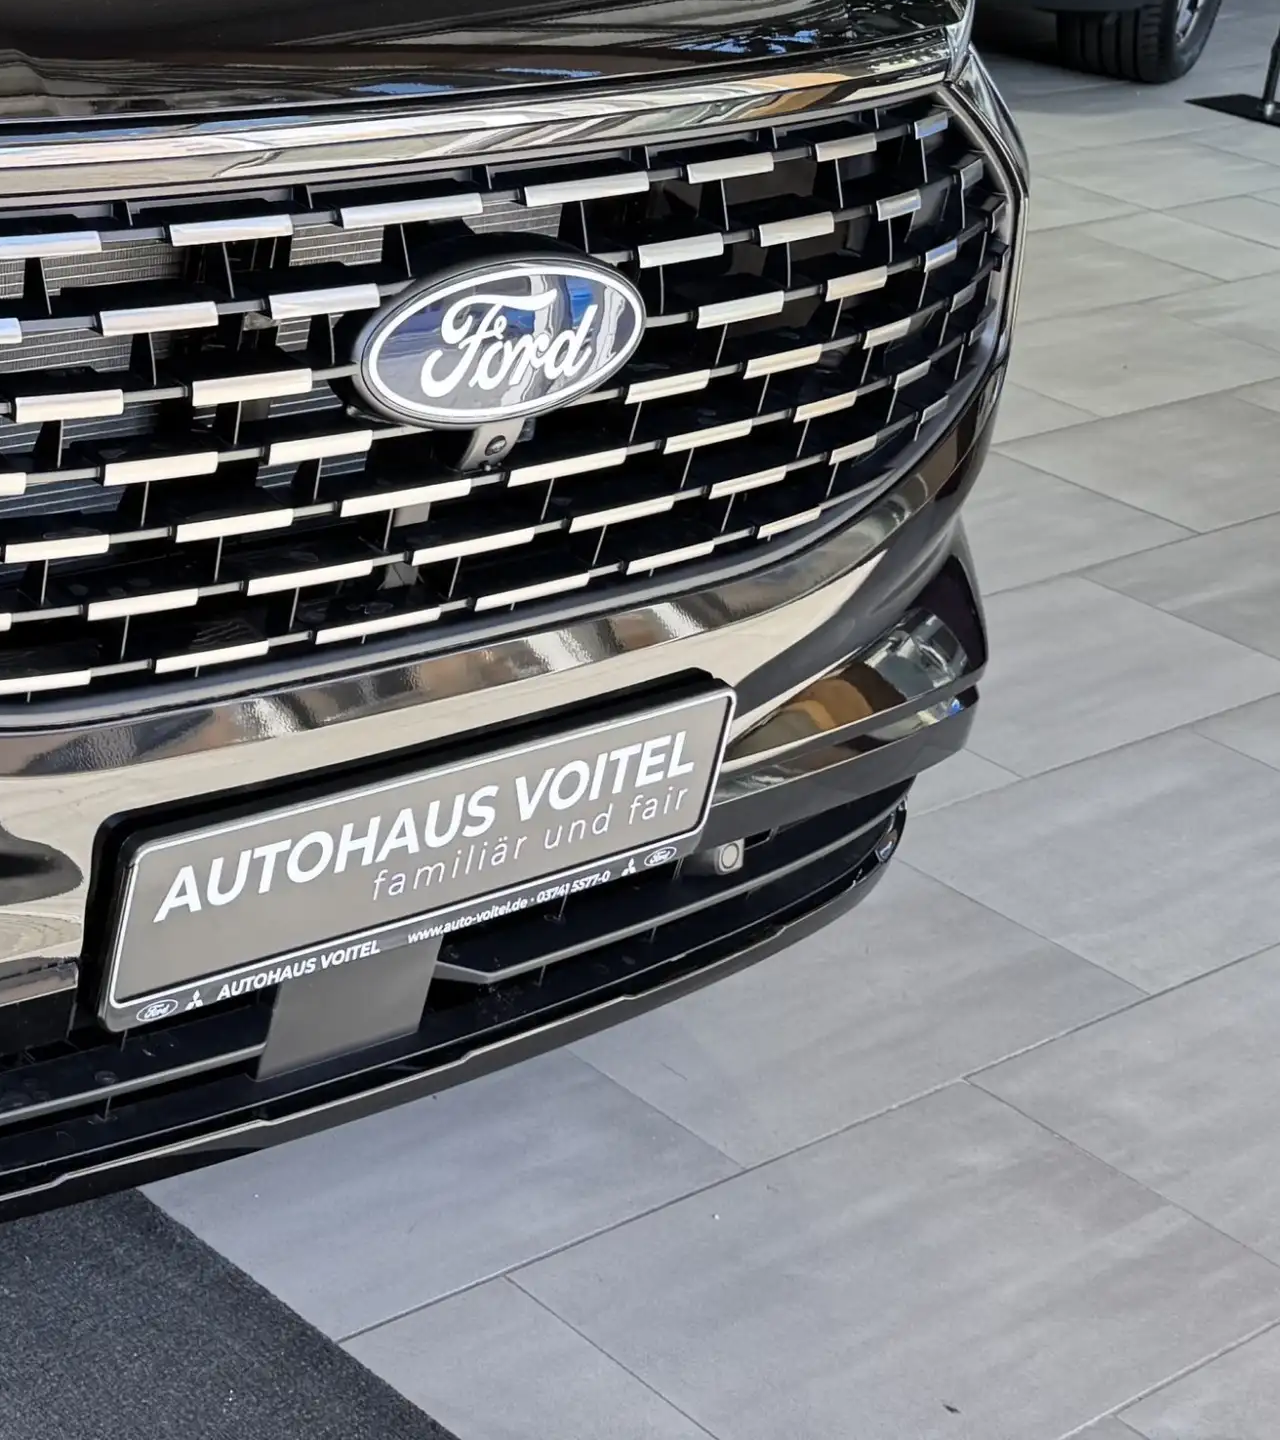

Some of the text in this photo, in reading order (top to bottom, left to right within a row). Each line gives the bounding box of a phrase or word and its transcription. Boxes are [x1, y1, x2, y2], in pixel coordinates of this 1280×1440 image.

[421, 289, 598, 398] Ford
[152, 730, 696, 923] AUTOHAUS VOITEL
[373, 787, 690, 901] familiär und fair
[216, 957, 317, 1001] AUTOHAUS
[319, 939, 381, 970] VOITEL
[407, 896, 528, 944] www.auto-voitel.de
